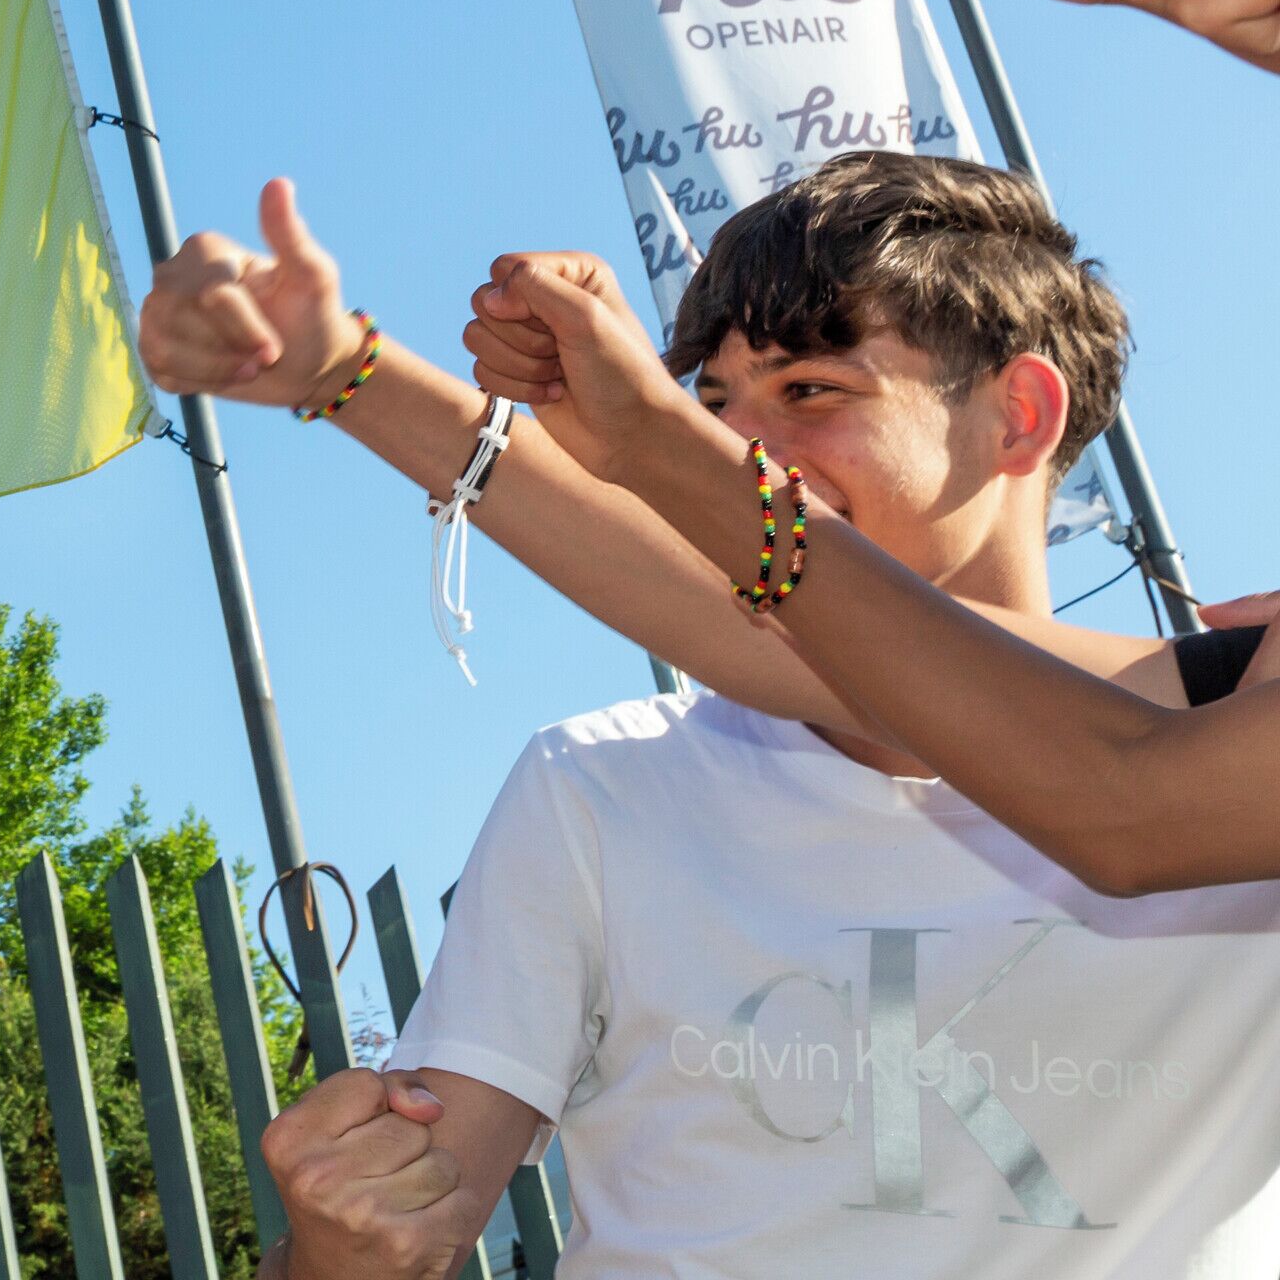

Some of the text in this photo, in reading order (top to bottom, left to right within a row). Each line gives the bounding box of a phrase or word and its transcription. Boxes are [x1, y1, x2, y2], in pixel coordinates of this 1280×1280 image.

[686, 17, 849, 51] OPENAIR
[683, 107, 762, 154] hu
[777, 86, 888, 151] hu
[670, 1025, 1191, 1102] Calvin Klein Jeans
